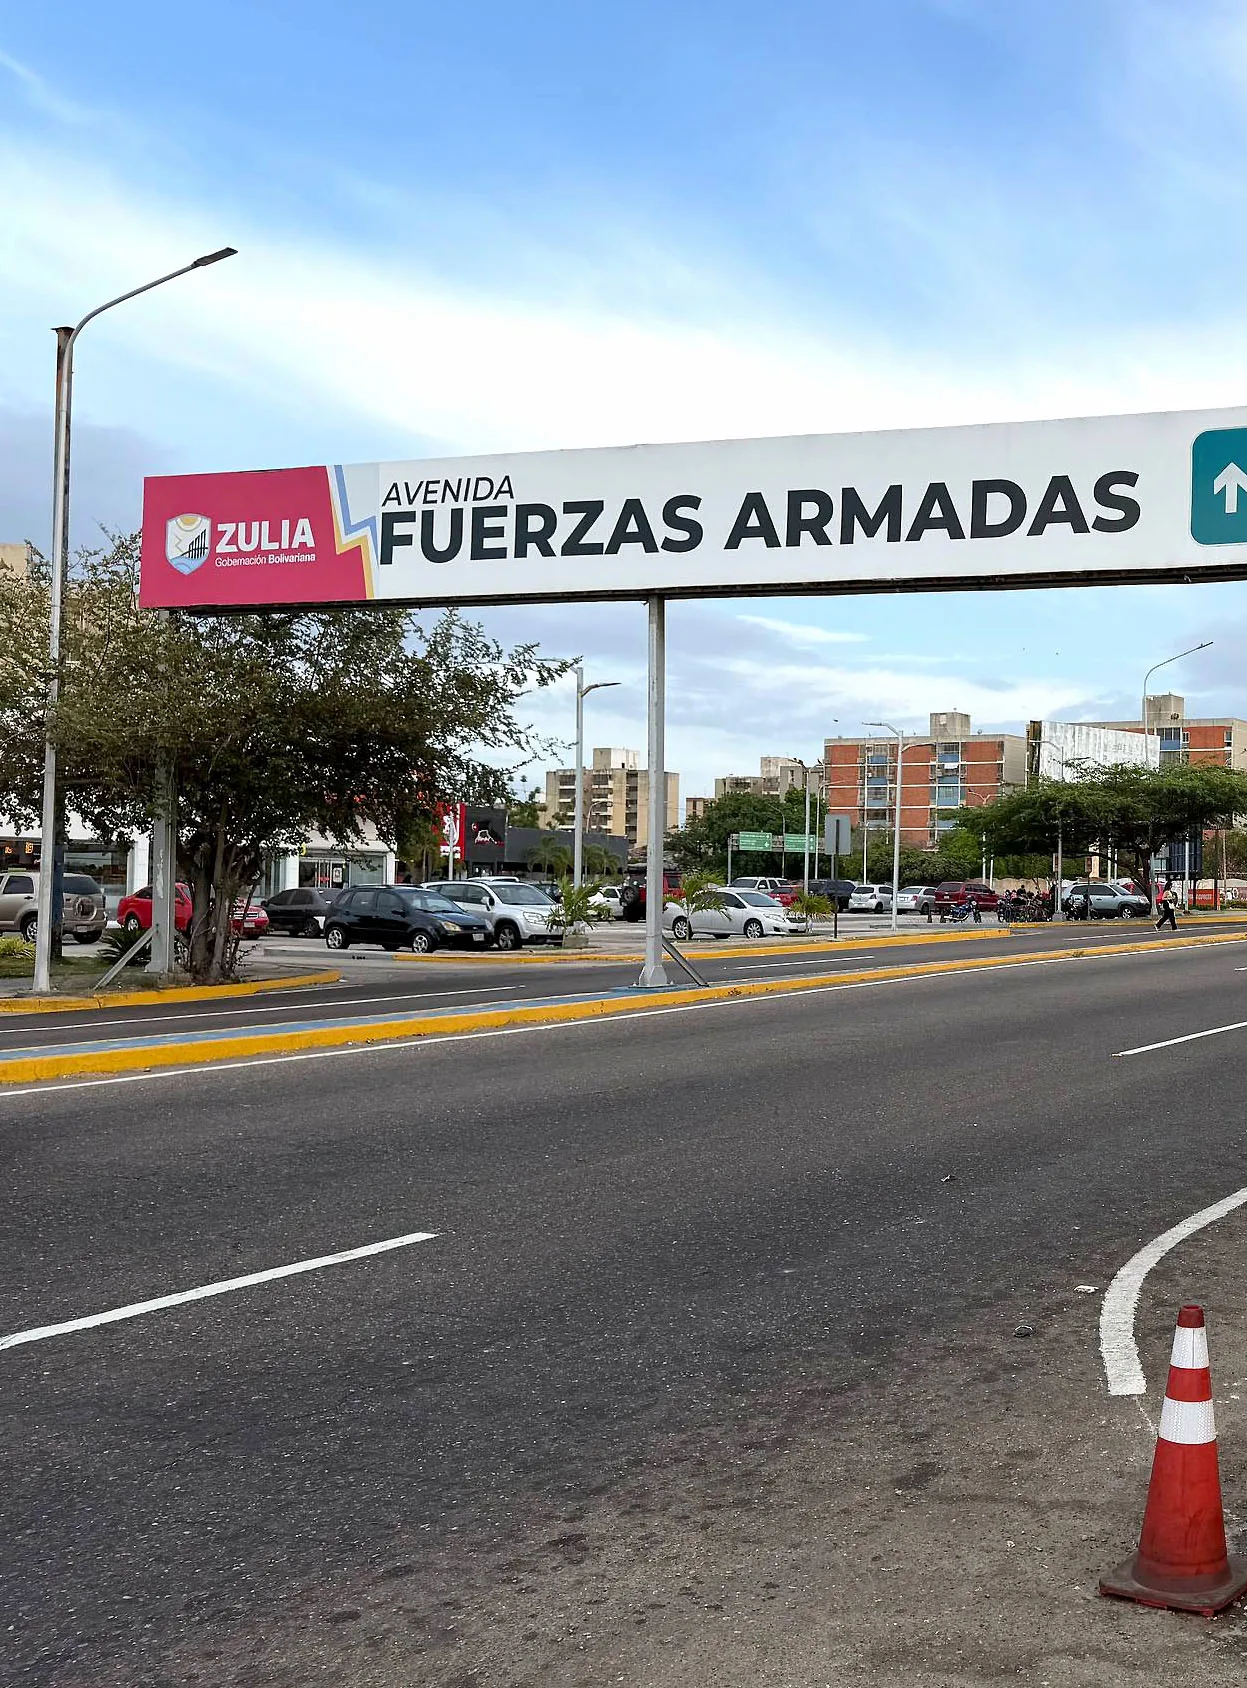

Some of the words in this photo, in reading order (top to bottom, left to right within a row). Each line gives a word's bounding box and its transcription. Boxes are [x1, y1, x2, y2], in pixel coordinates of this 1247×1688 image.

[381, 475, 515, 507] AVENIDA
[379, 494, 704, 566] FUERZAS
[723, 470, 1141, 550] ARMADAS
[215, 518, 316, 554] ZULIA
[215, 554, 267, 568] Gobernación
[268, 552, 316, 565] Bolivariana
